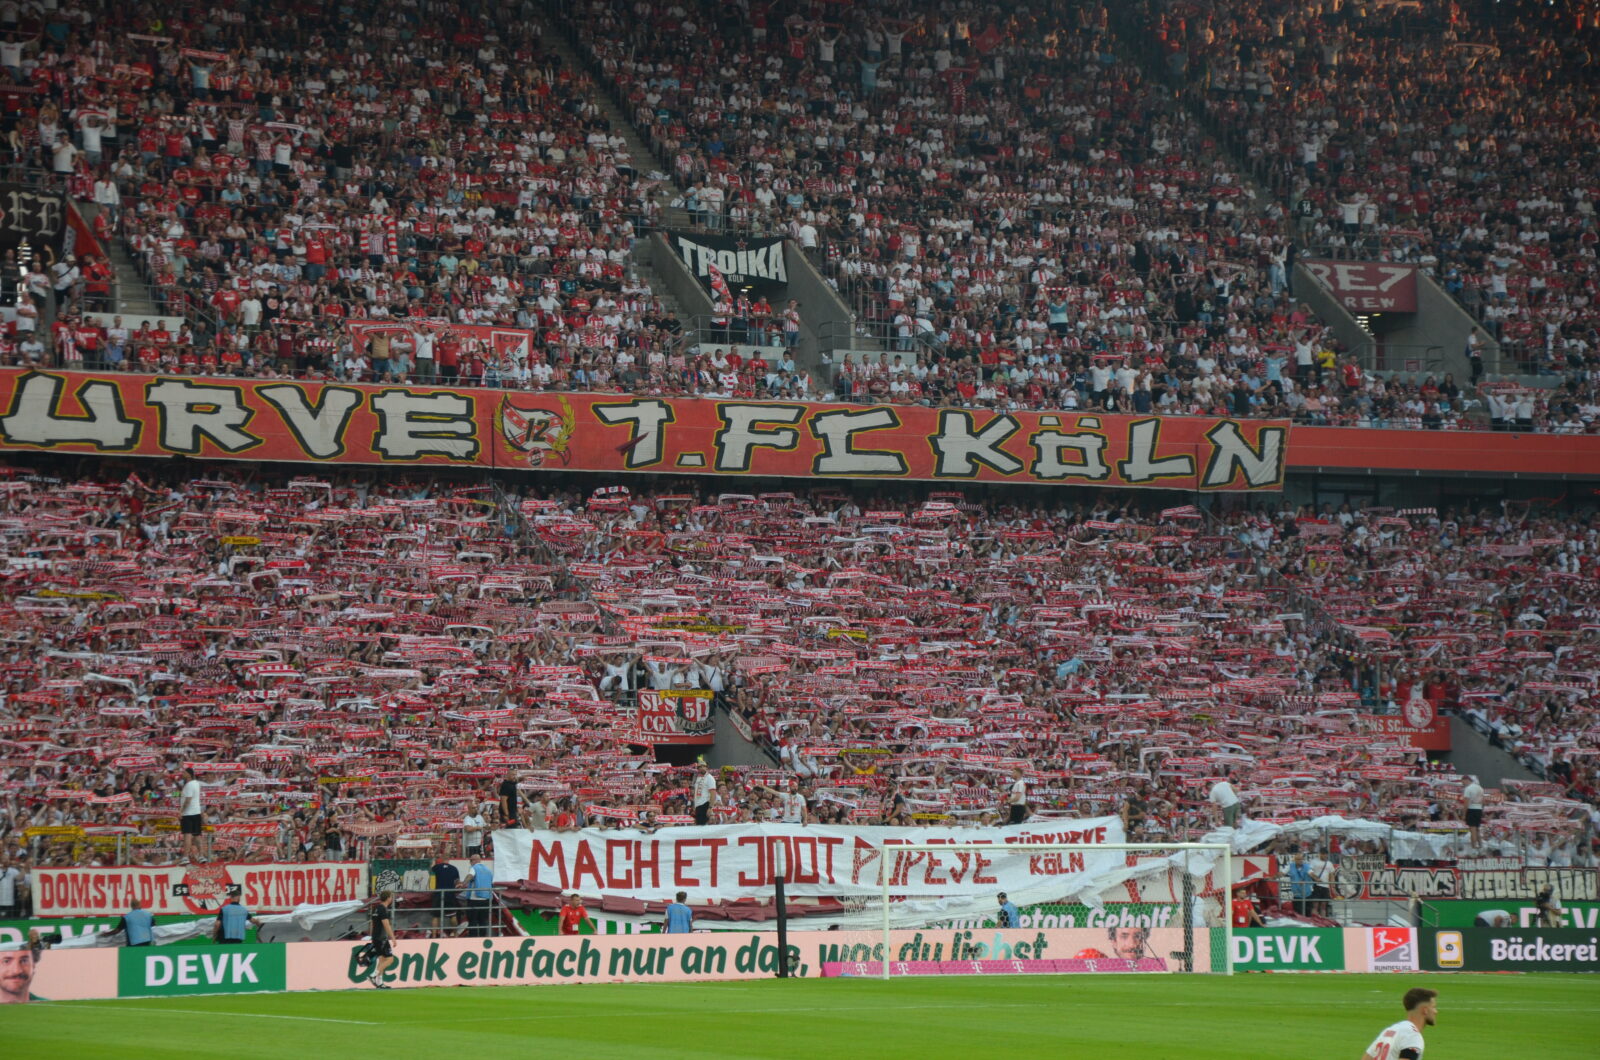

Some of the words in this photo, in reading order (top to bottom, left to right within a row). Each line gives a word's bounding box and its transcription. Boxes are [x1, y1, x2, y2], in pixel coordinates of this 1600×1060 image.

[678, 236, 788, 283] TROIKA
[525, 418, 550, 442] 12
[927, 409, 1286, 488] KÖLN
[642, 715, 677, 732] CGN
[528, 839, 661, 889] MACH
[674, 838, 728, 887] ET
[738, 835, 844, 886] JOOT
[851, 835, 998, 886] POPEYE
[1030, 853, 1084, 875] KÖLN
[40, 873, 170, 909] DOMSTADT
[245, 868, 361, 907] SYNDIKAT
[347, 942, 450, 984] Denk
[458, 938, 601, 980] einfach
[608, 947, 674, 976] nur
[681, 945, 727, 974] an
[898, 932, 943, 961] du
[1232, 936, 1323, 962] DEVK
[1400, 944, 1412, 962] 2
[1491, 937, 1597, 961] Bäckerei
[145, 953, 258, 986] DEVK
